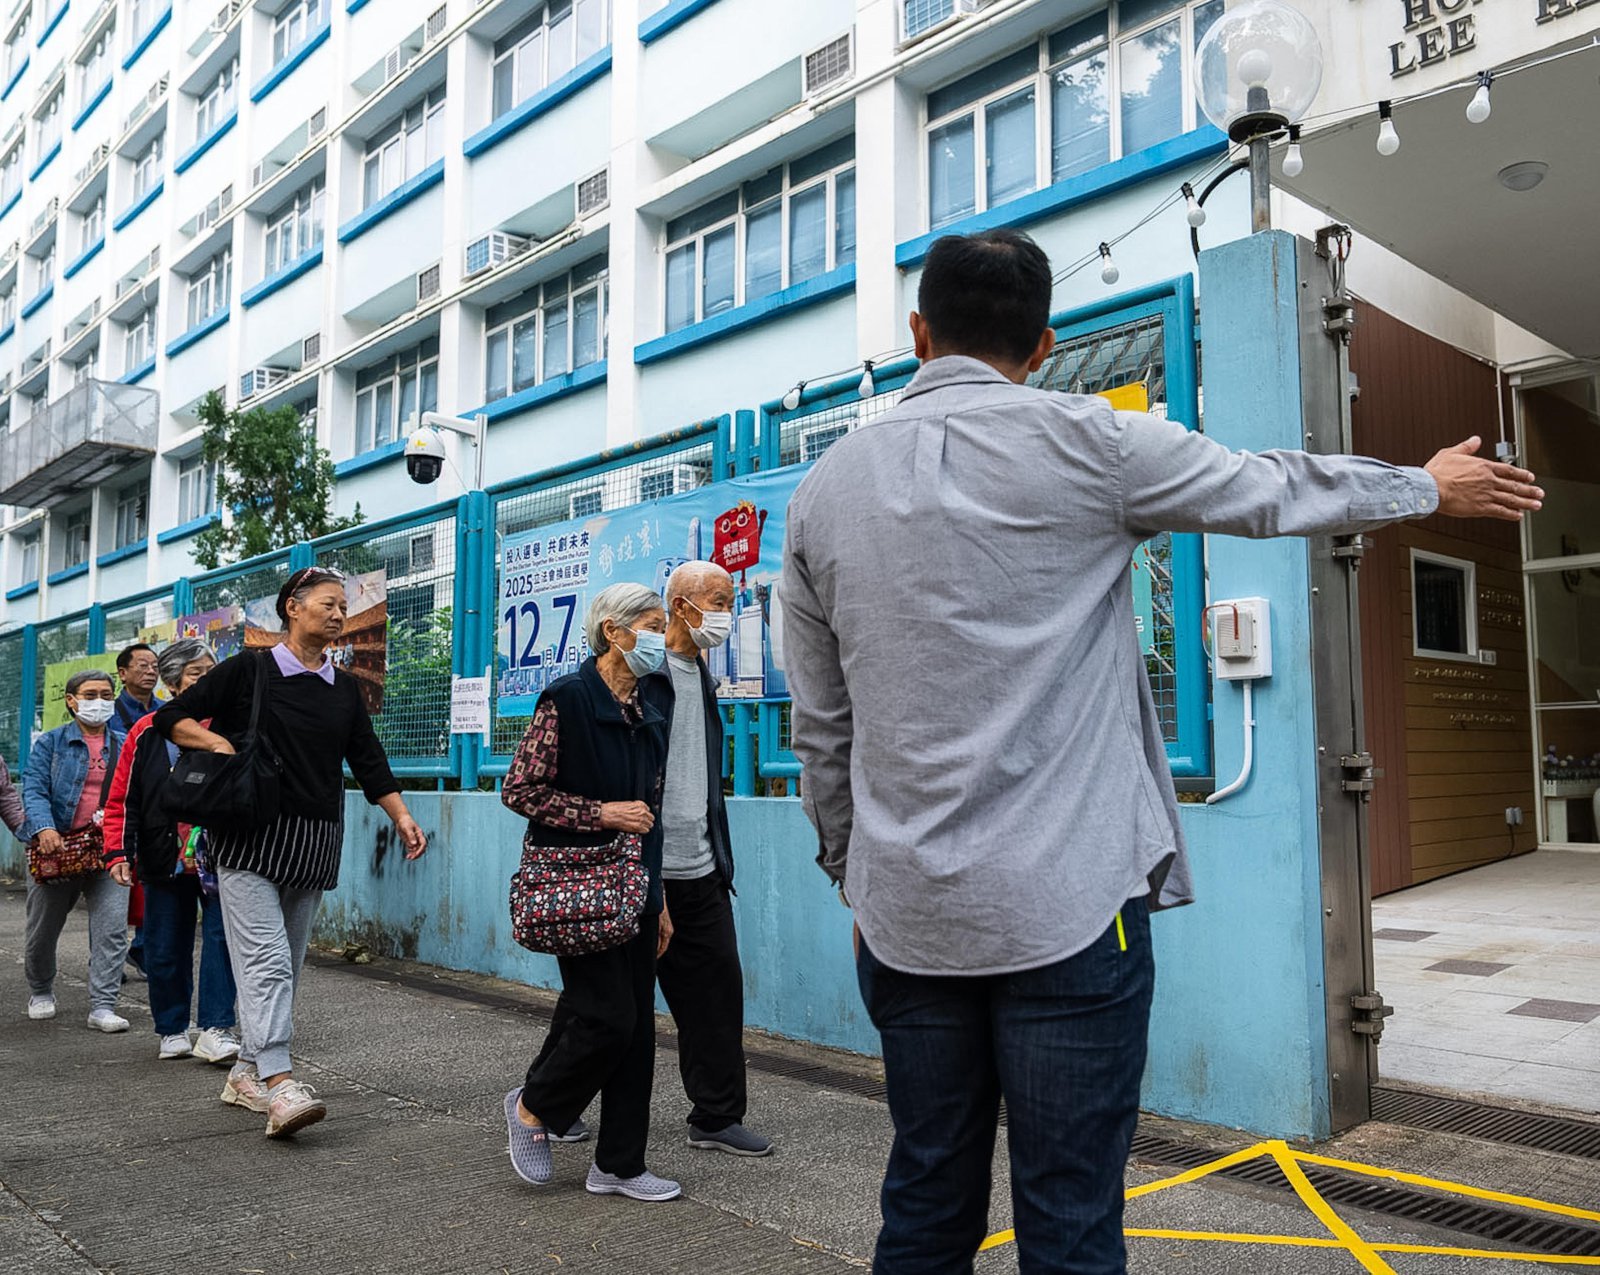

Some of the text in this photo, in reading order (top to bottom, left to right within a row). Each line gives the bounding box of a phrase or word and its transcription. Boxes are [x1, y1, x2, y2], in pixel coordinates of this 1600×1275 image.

[1388, 14, 1476, 78] LEE
[506, 531, 589, 565] 投入選舉 共創未來
[723, 537, 749, 560] 投票箱
[505, 562, 588, 598] 2025 立法會換屆選舉
